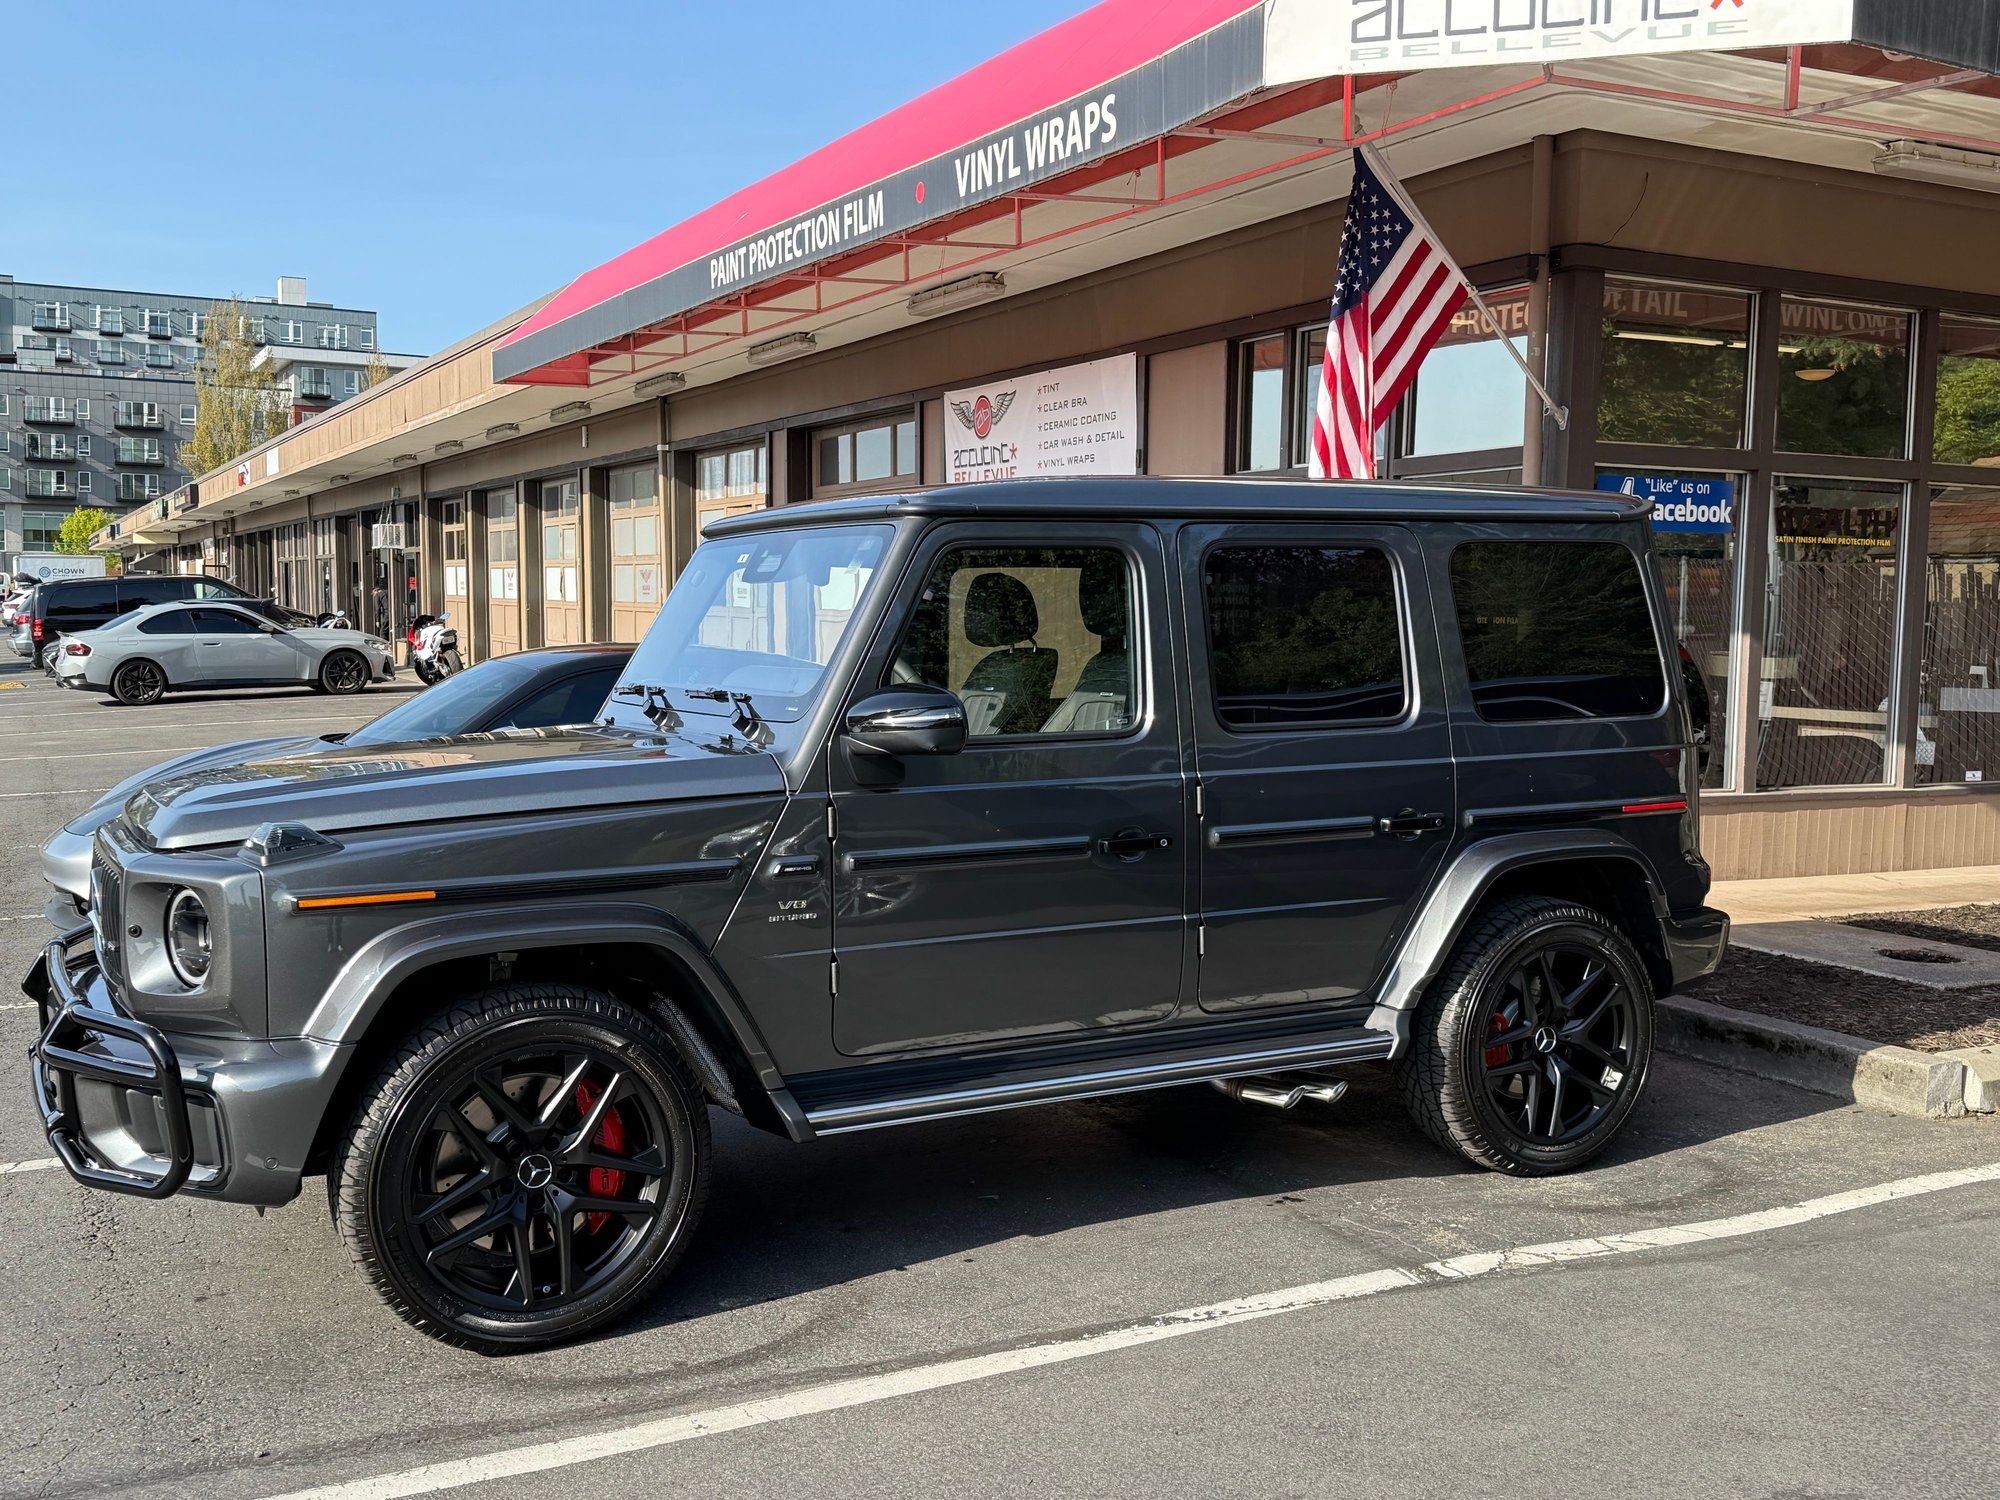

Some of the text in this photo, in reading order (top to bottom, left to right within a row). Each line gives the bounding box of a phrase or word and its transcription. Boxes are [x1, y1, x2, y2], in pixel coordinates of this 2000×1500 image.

[1350, 19, 1748, 61] BELLEVUE
[955, 93, 1117, 197] VINYL WRAPS
[710, 190, 884, 289] PAINT PROTECTION FILM
[1043, 383, 1060, 393] TINT
[1043, 397, 1087, 412] CLEAR BRA
[1043, 411, 1117, 431] CERAMIC COATING
[1043, 430, 1125, 449] CAR WASH & DETAIL
[1043, 454, 1095, 468] VINYL WRAPS
[1681, 482, 1694, 494] us
[1696, 483, 1710, 494] on
[1795, 536, 1816, 544] FINISH
[1818, 537, 1836, 545] PAINT
[1838, 538, 1876, 546] PROTECTION
[1877, 539, 1891, 547] FILM
